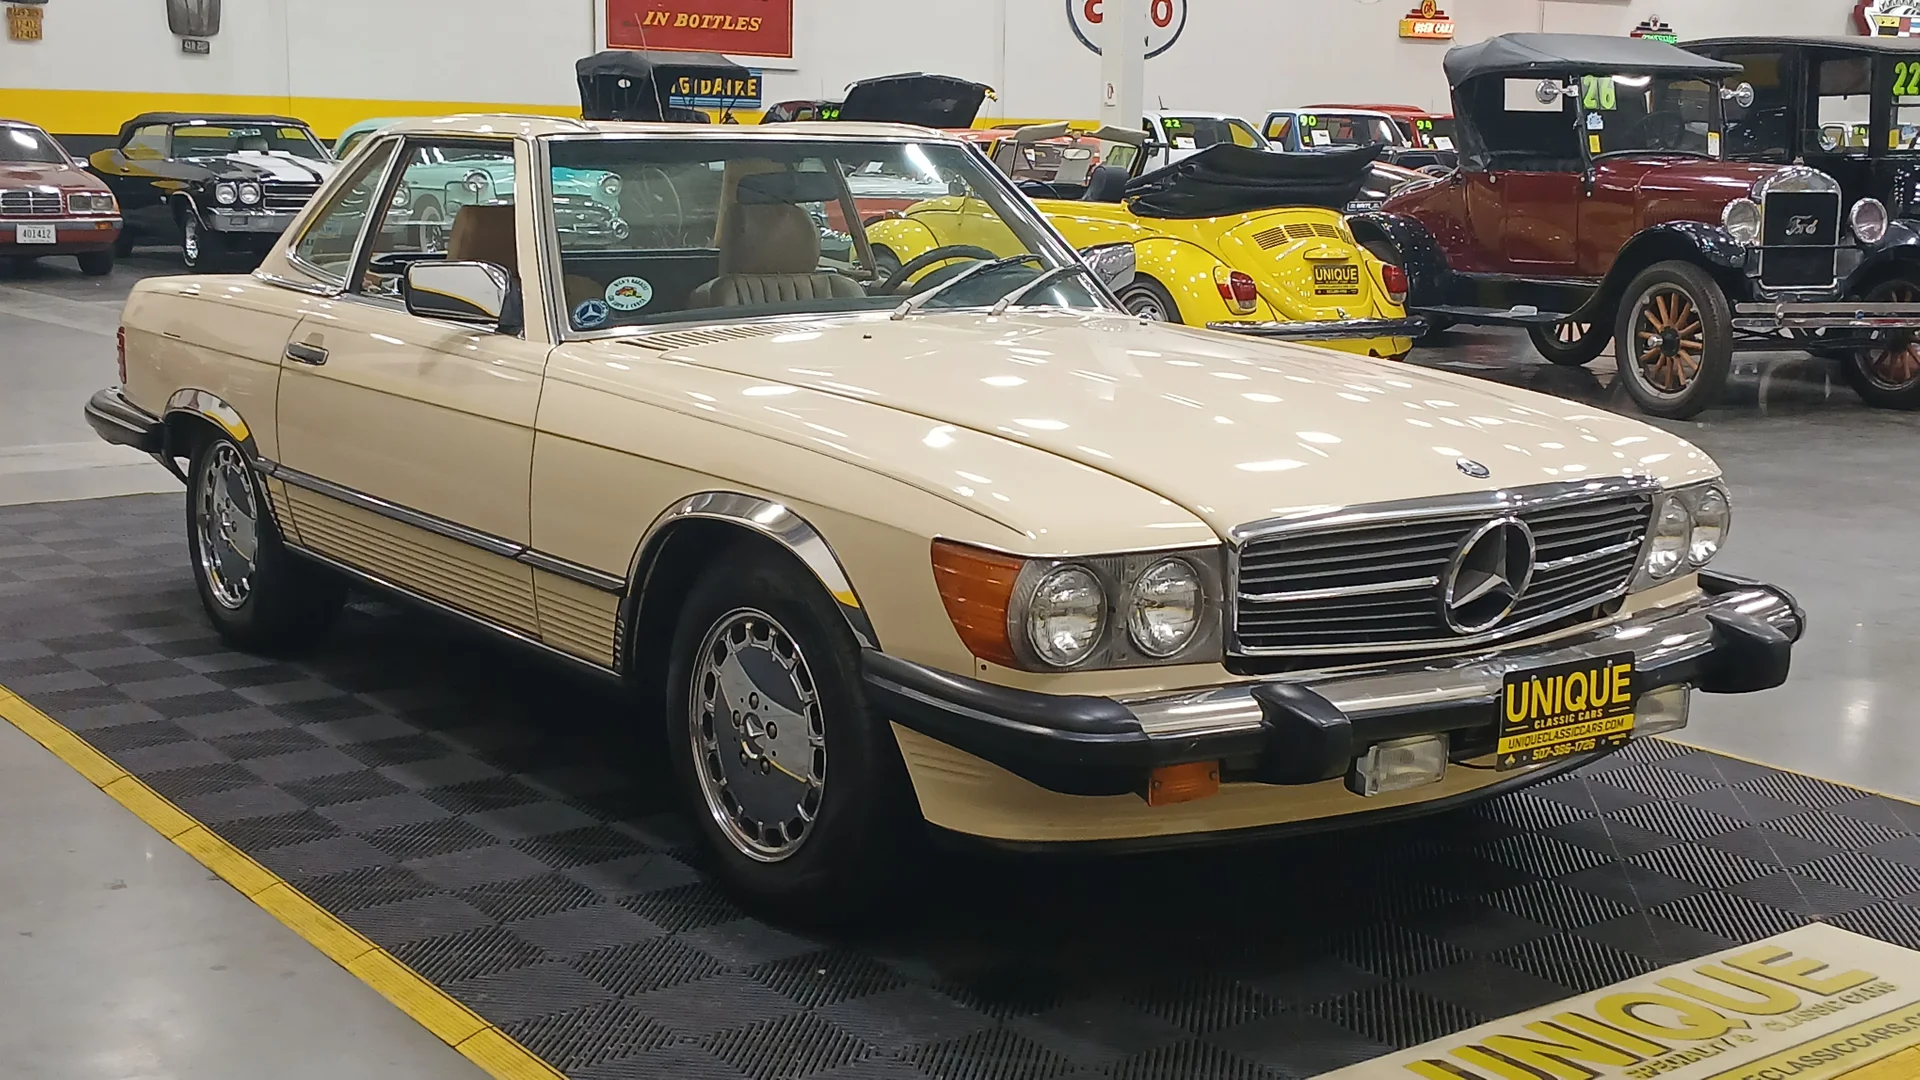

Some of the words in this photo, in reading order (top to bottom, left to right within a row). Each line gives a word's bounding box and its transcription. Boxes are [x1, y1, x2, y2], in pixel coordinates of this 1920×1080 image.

[643, 11, 670, 26] IN
[673, 13, 762, 32] BOTTLES
[670, 77, 757, 97] GIDAIRE
[1893, 61, 1920, 96] 22
[1583, 75, 1617, 110] 26
[1164, 119, 1181, 128] 22
[1299, 114, 1317, 127] 90
[1785, 214, 1819, 236] Ford
[1314, 268, 1358, 281] UNIQUE
[1506, 663, 1631, 722] UNIQUE
[1534, 714, 1575, 730] CLASSIC
[1578, 708, 1603, 721] CARS
[1508, 718, 1625, 749] UNIQUECLASSICCARS.COM
[1761, 997, 1848, 1032] CLASSIC
[1741, 1012, 1920, 1080] CLASSICCARS.C
